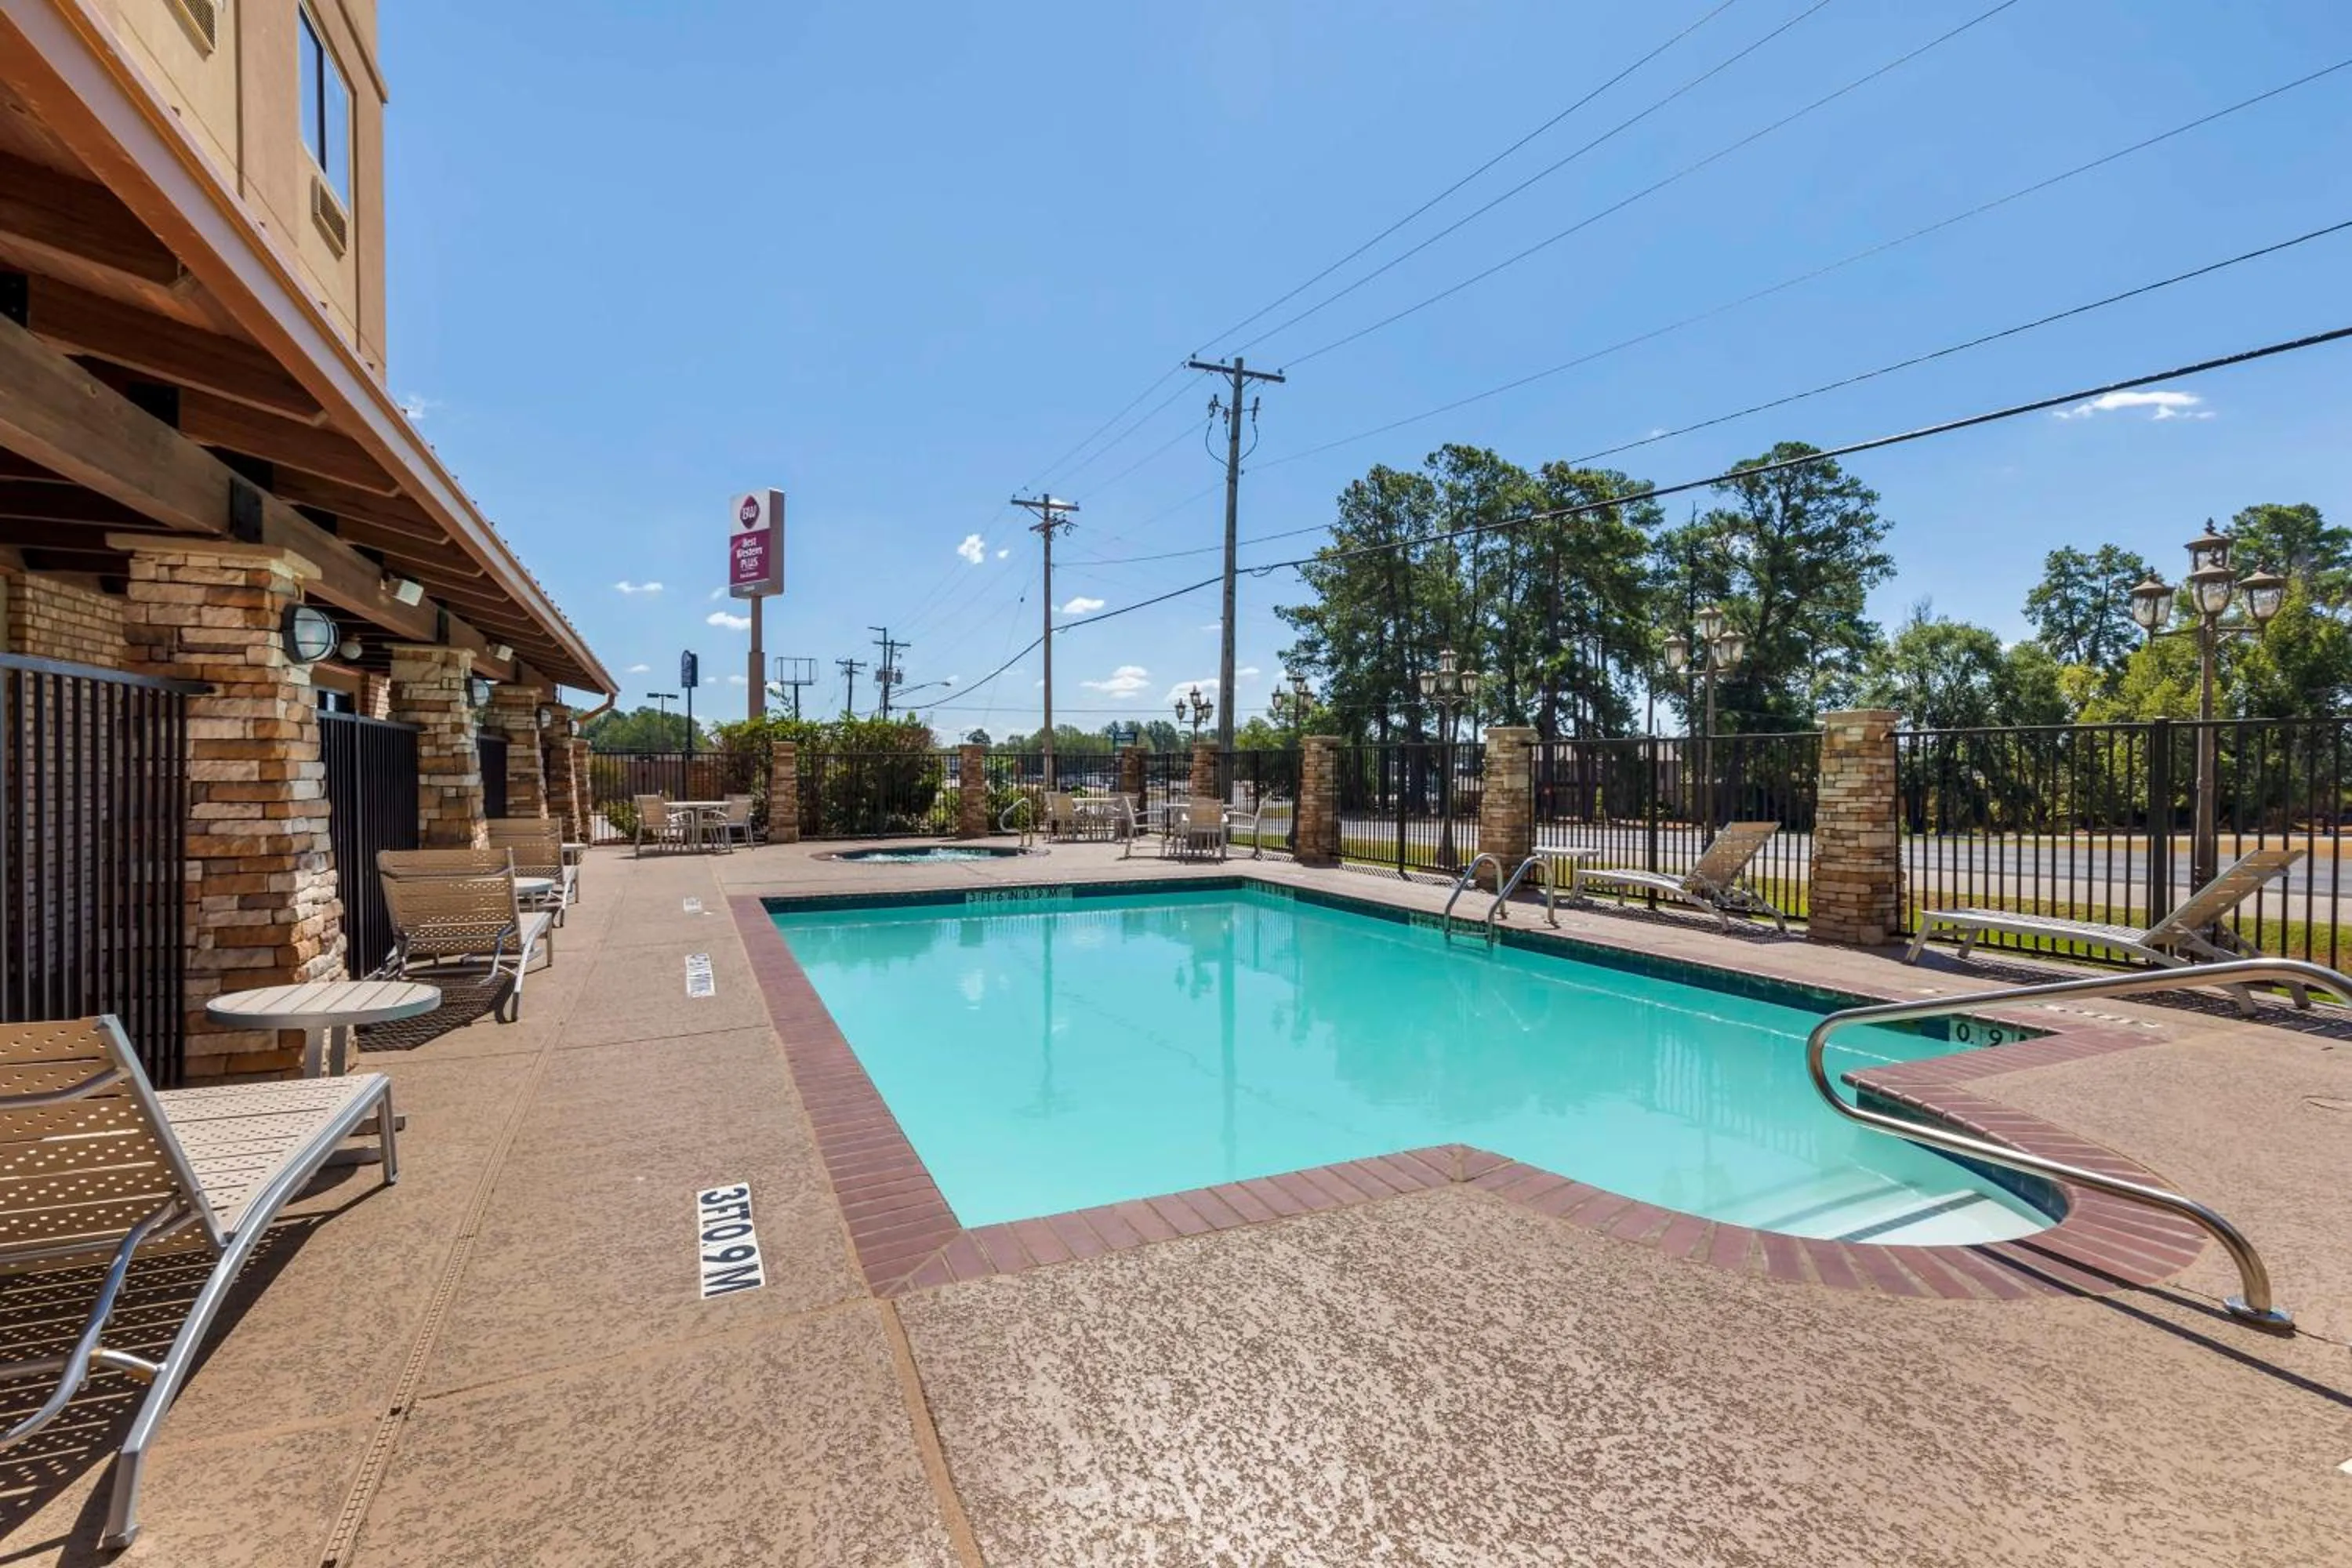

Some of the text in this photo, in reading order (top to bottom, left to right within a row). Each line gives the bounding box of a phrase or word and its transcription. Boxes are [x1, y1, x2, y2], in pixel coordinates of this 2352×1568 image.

[742, 506, 757, 520] BW
[742, 537, 757, 548] Best
[736, 546, 763, 559] Western
[740, 557, 758, 569] PLUS
